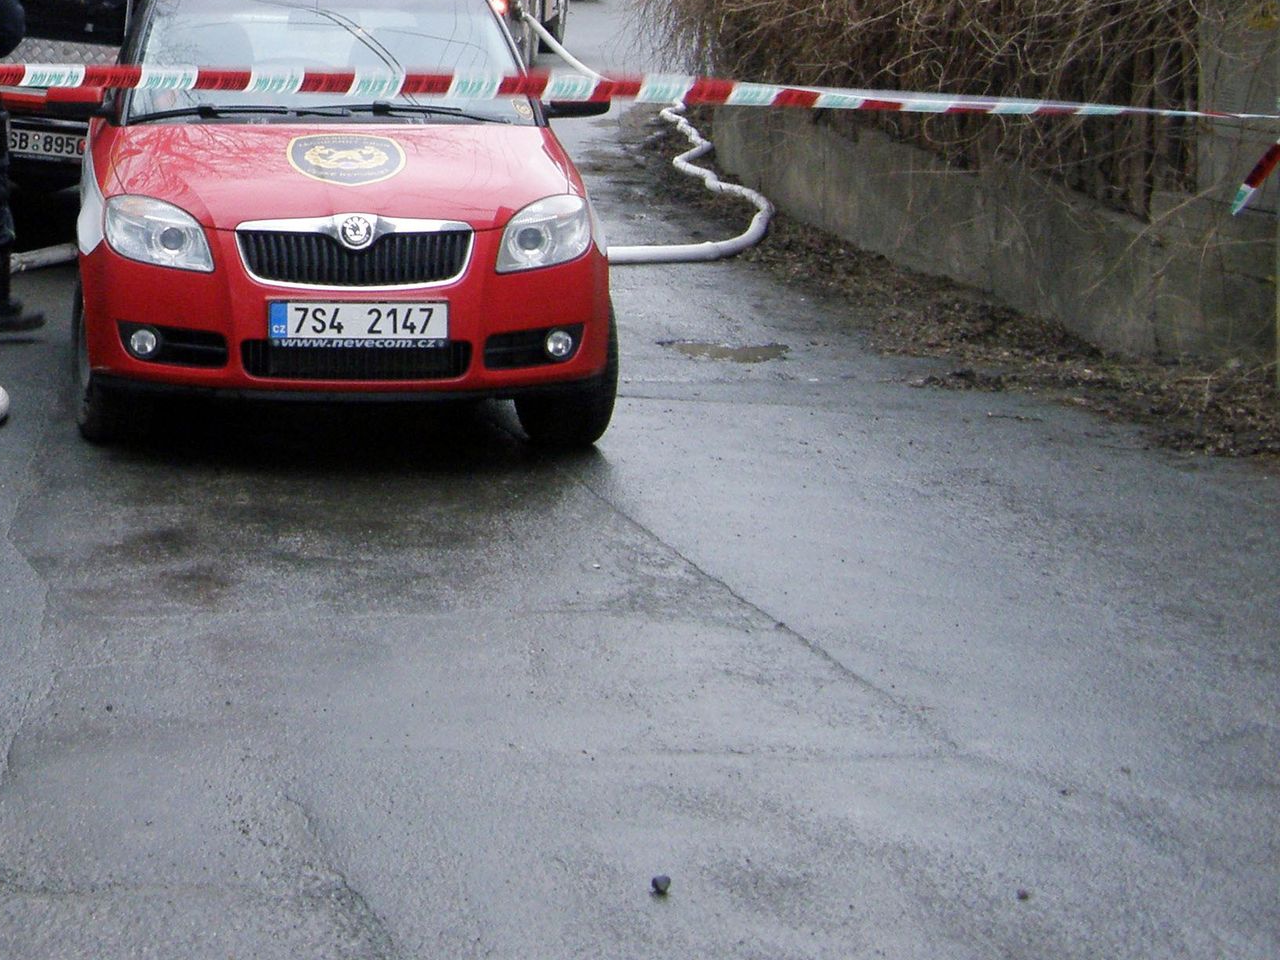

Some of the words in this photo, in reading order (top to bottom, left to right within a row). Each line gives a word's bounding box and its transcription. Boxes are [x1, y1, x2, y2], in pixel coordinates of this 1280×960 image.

[293, 306, 345, 335] 7S4
[366, 307, 435, 335] 2147
[272, 325, 287, 335] CZ
[280, 338, 436, 349] www.nevecom.cz
